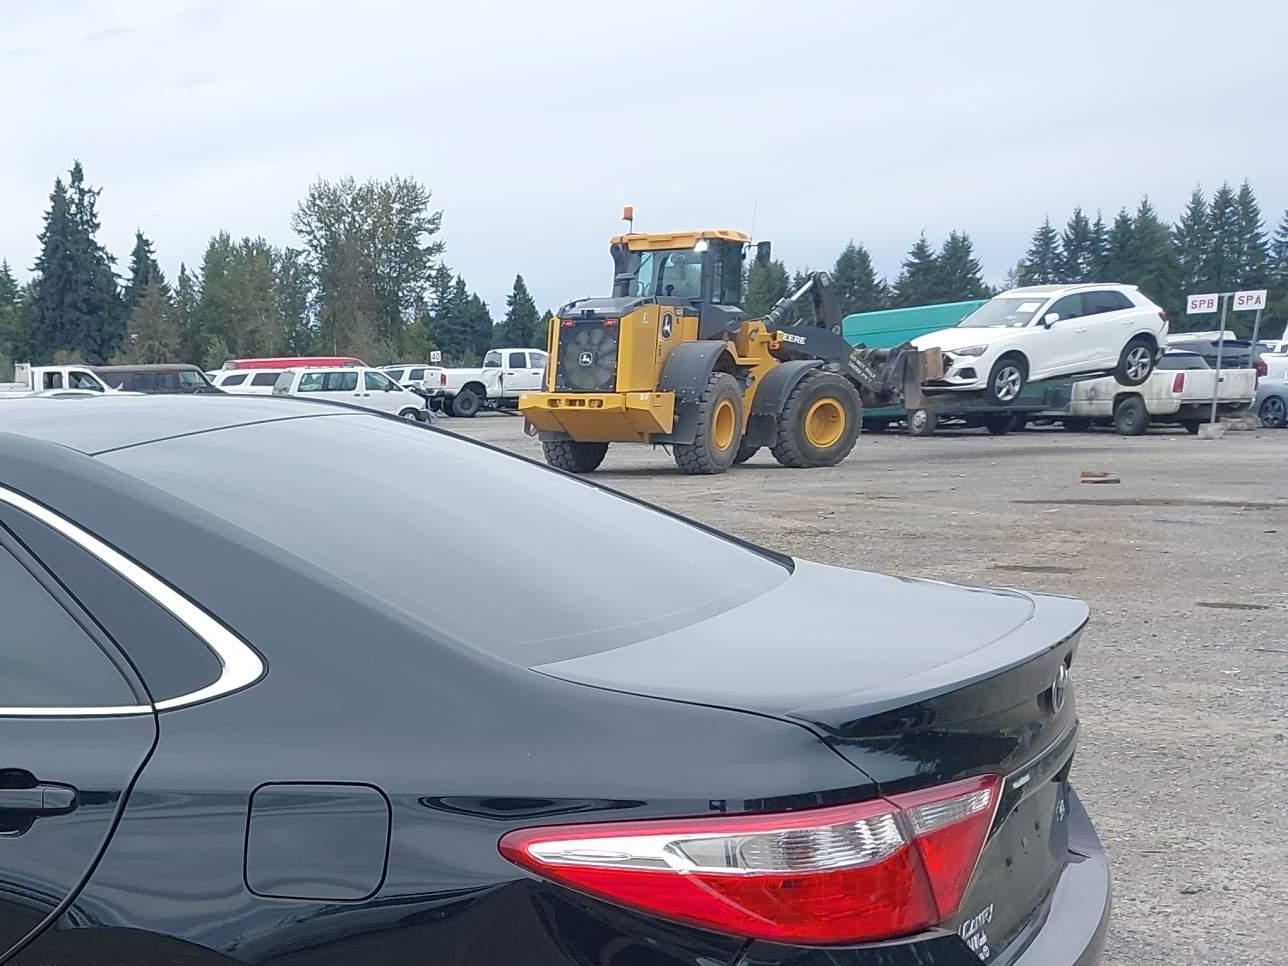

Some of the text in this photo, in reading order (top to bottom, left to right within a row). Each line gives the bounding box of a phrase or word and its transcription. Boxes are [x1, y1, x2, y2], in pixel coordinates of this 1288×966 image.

[1191, 299, 1215, 309] SPB
[1237, 295, 1262, 306] SPA
[783, 333, 807, 345] EERE
